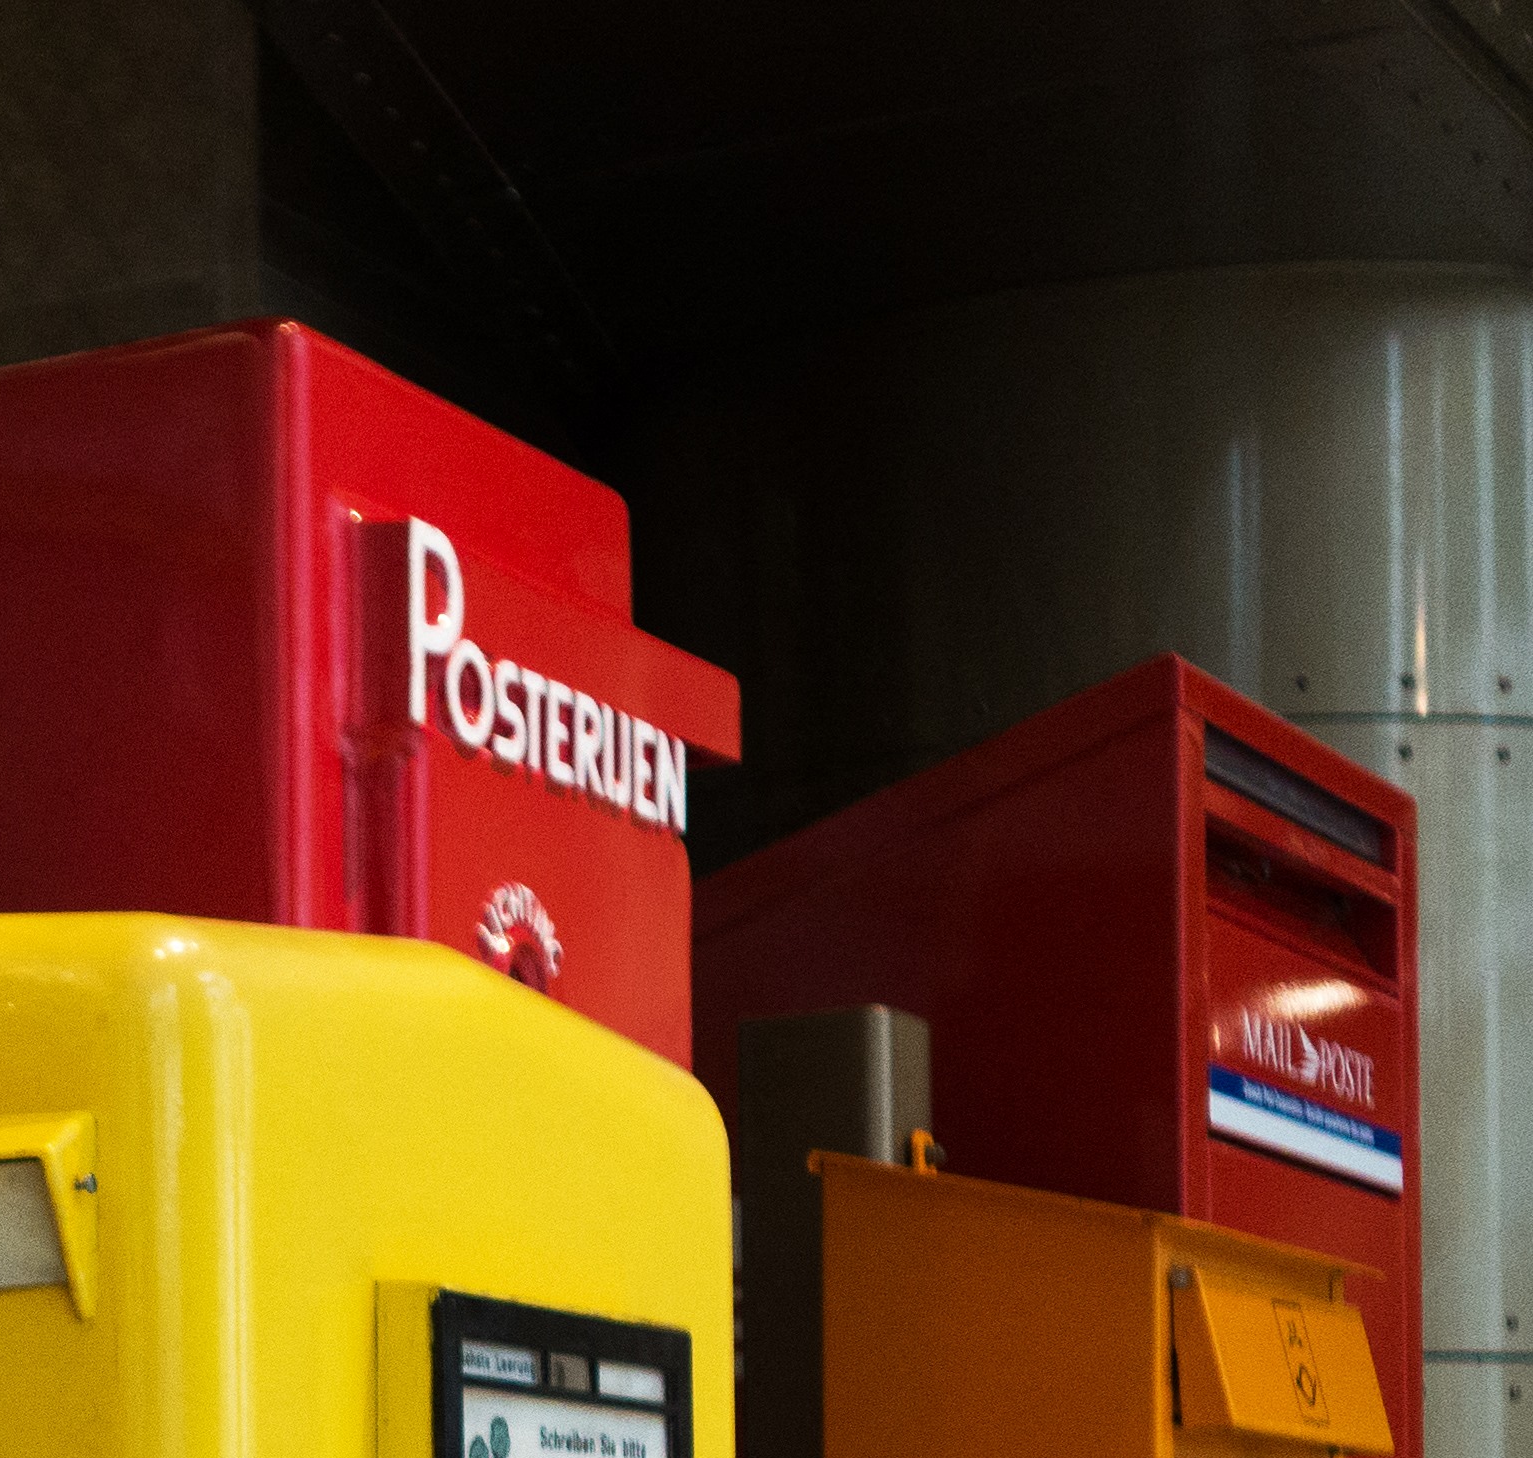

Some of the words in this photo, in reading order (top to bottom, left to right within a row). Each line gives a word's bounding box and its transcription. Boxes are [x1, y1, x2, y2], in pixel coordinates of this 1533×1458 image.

[1242, 1005, 1299, 1080] MAIL
[1318, 1037, 1375, 1110] POSTE
[539, 1424, 596, 1454] Schreiben
[600, 1432, 616, 1457] Sie
